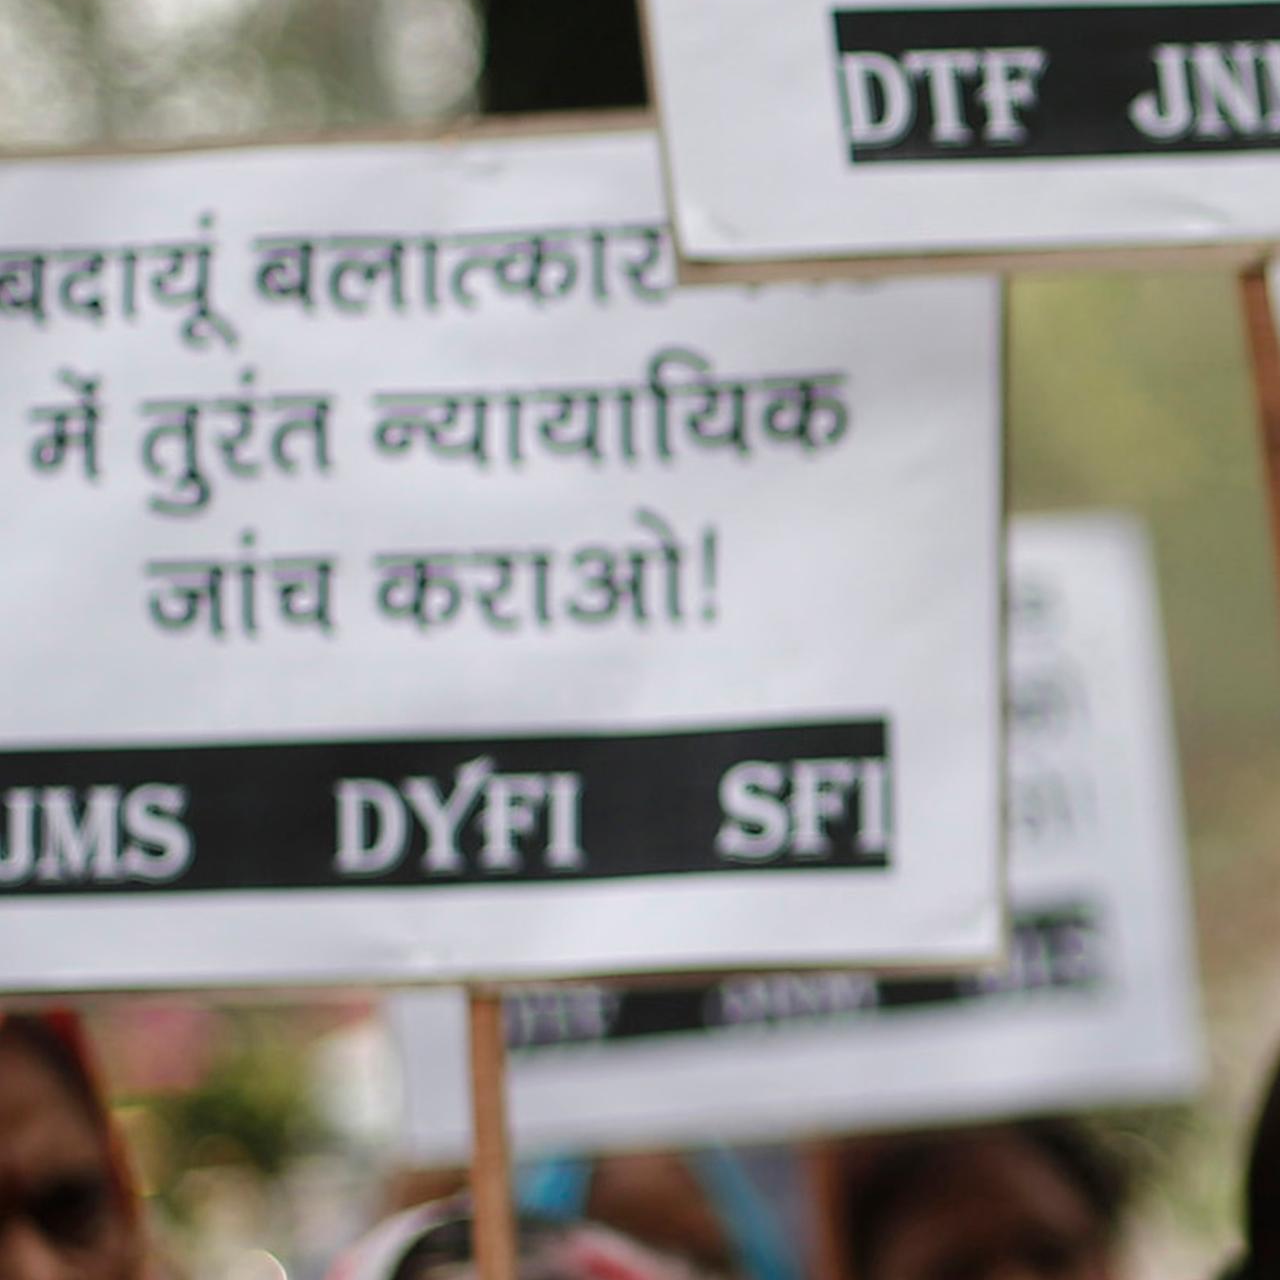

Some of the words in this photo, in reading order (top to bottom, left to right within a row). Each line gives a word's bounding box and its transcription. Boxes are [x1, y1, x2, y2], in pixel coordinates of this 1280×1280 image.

[840, 51, 1045, 148] DTF
[253, 224, 673, 314] बलात्कार
[28, 369, 104, 480] में
[139, 369, 337, 515] तुरंत
[145, 527, 336, 637] जांच
[371, 507, 720, 630] कराओ!
[0, 782, 197, 888] JMS
[334, 756, 590, 876] DYFI
[716, 756, 889, 863] SFI
